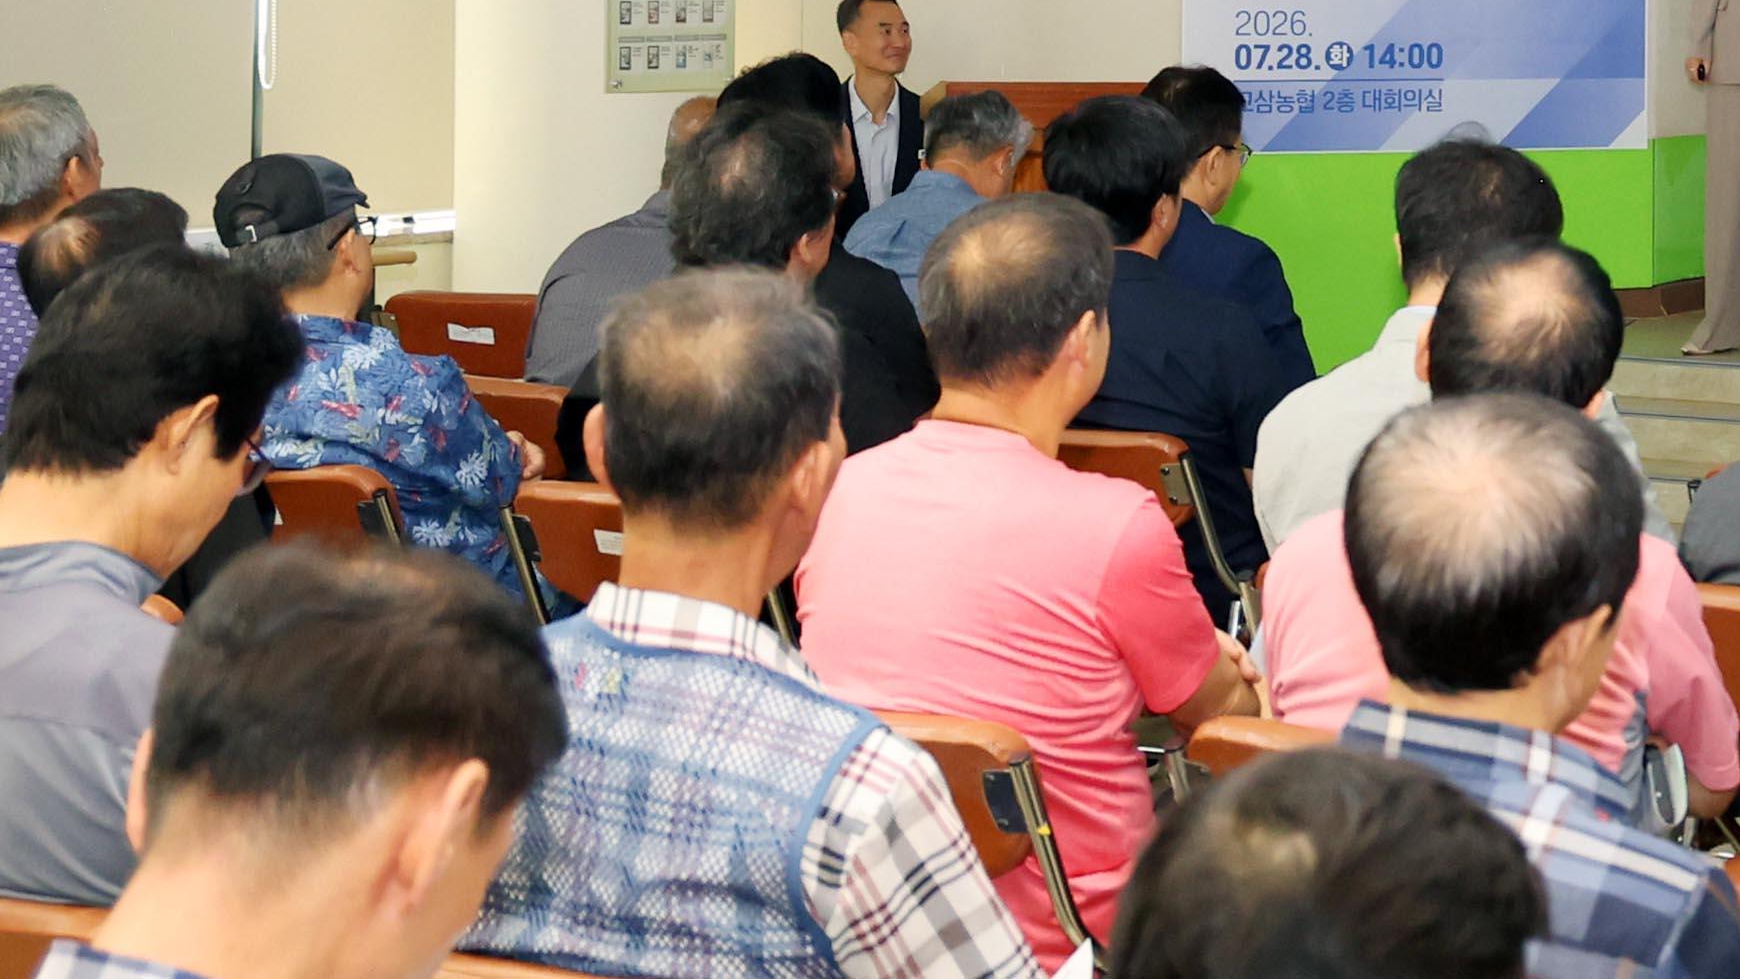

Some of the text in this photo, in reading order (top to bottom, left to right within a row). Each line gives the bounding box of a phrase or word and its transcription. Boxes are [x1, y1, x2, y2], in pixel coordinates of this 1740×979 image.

[1235, 10, 1313, 37] 2026.
[1362, 42, 1444, 69] 14:00
[1322, 89, 1356, 113] 2층
[1362, 88, 1443, 113] 대회의실
